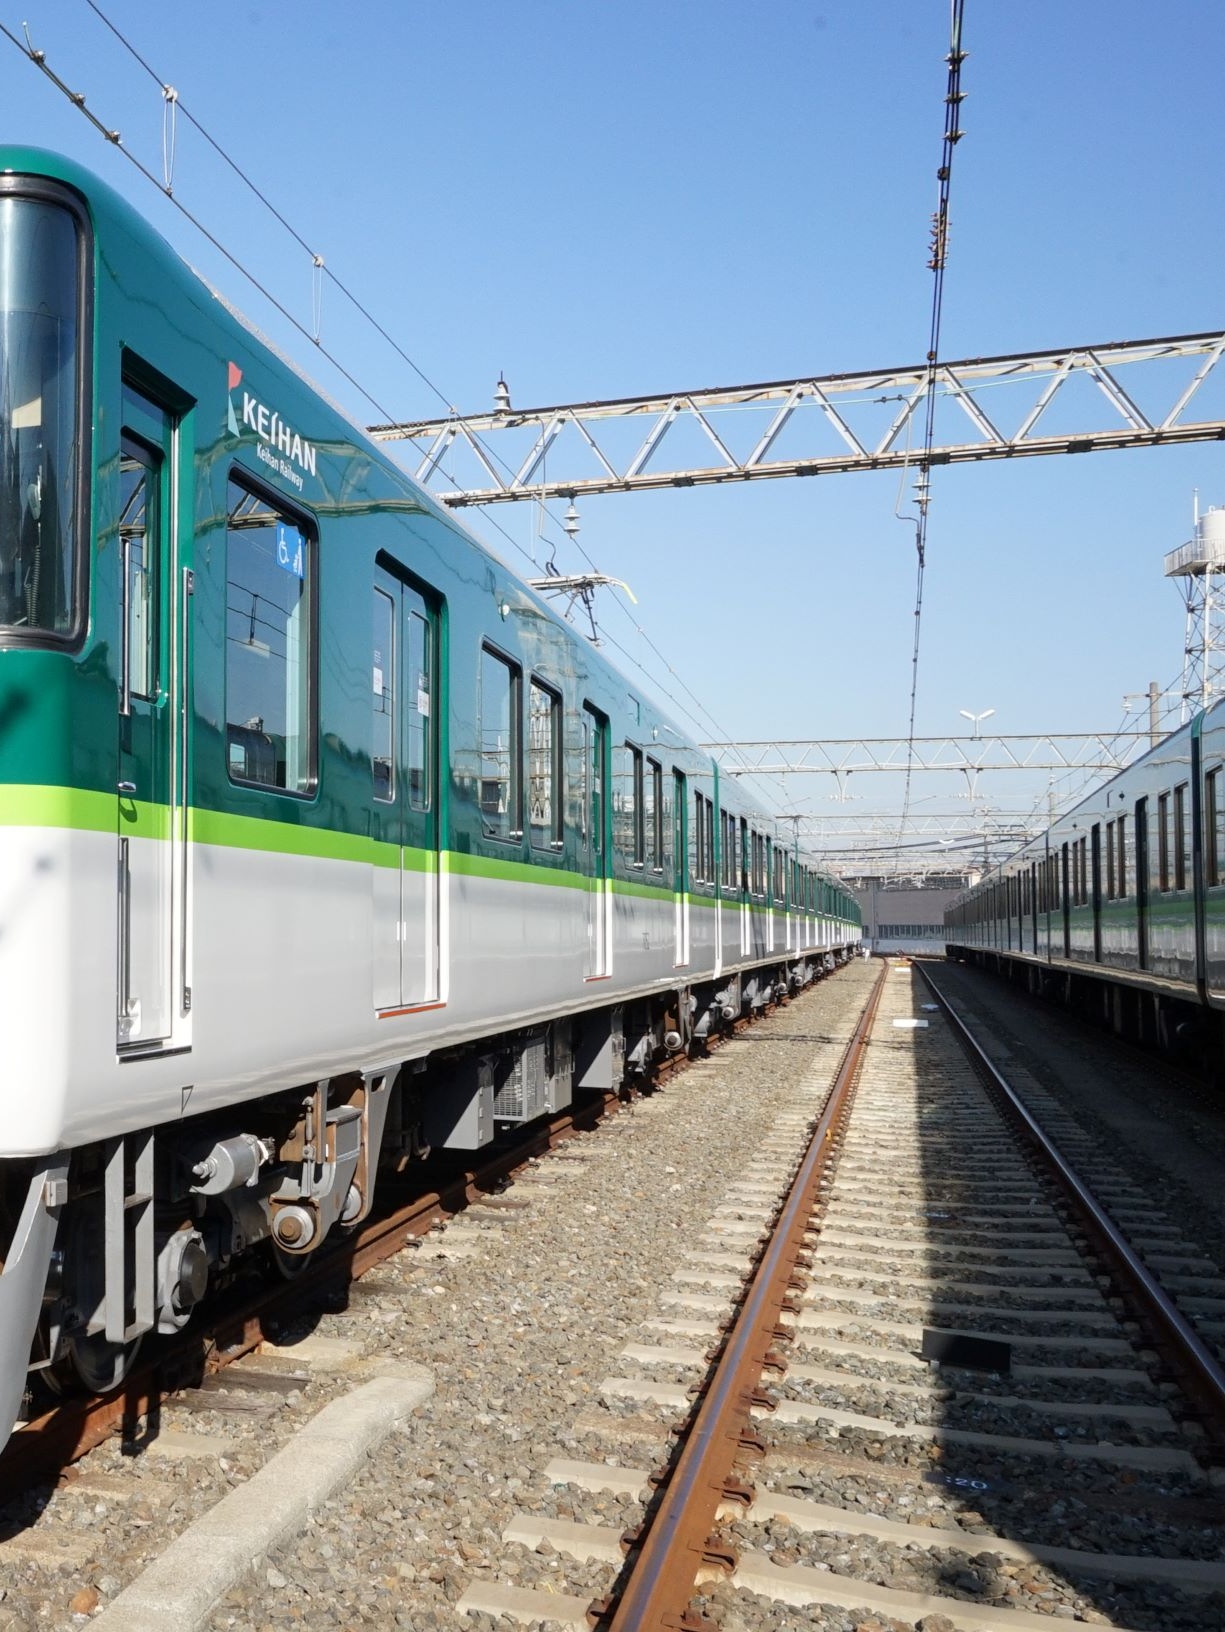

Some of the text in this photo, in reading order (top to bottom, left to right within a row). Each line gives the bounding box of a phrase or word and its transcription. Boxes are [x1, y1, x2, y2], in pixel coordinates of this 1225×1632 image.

[243, 391, 316, 477] KEIHAN
[256, 441, 304, 492] Keihan Railway
